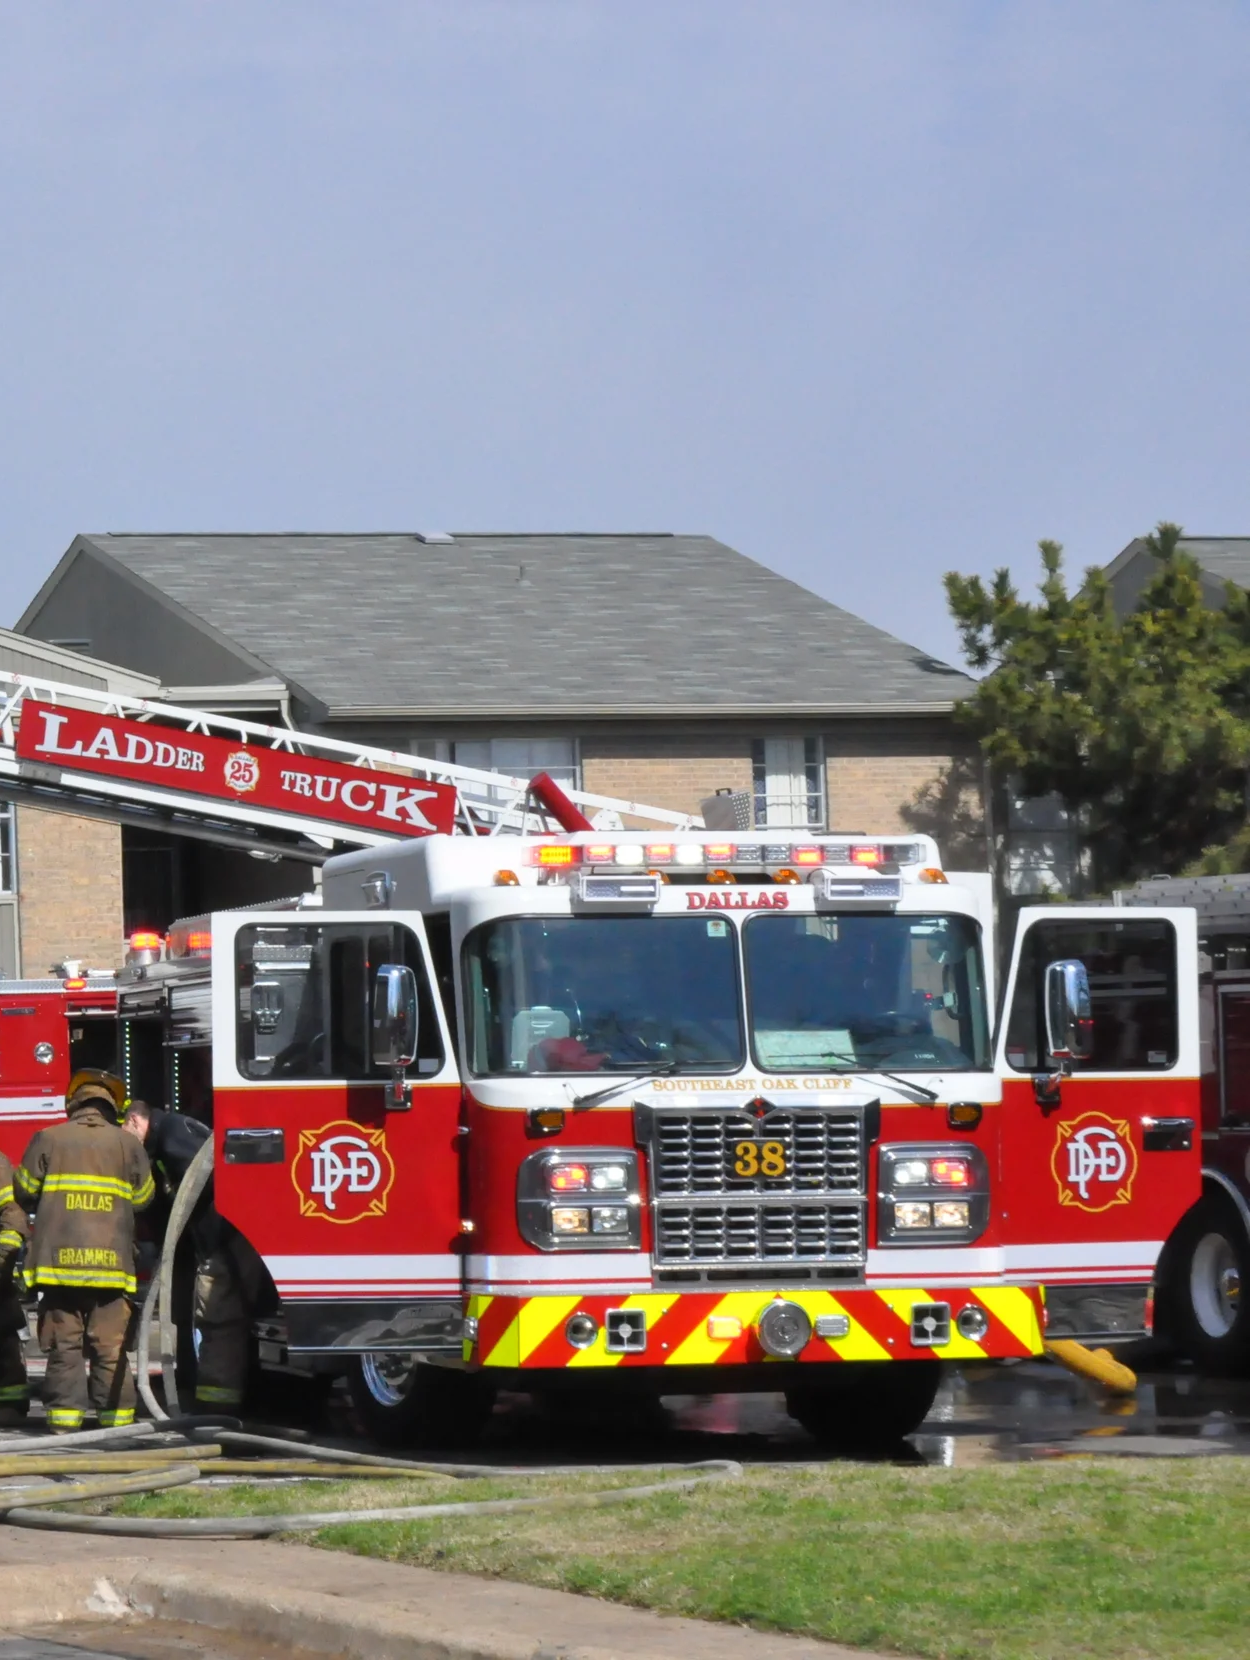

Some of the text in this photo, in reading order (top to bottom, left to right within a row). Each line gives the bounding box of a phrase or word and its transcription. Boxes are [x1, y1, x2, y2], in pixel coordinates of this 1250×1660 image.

[35, 711, 205, 772] LADDER
[230, 760, 254, 783] 25
[280, 770, 438, 831] TRUCK
[686, 891, 789, 910] DALLAS
[653, 1078, 853, 1091] SOUTHEAST OAK CLIFF
[734, 1141, 786, 1177] 38
[66, 1193, 114, 1212] DALLAS
[59, 1247, 117, 1267] GRAMMER
